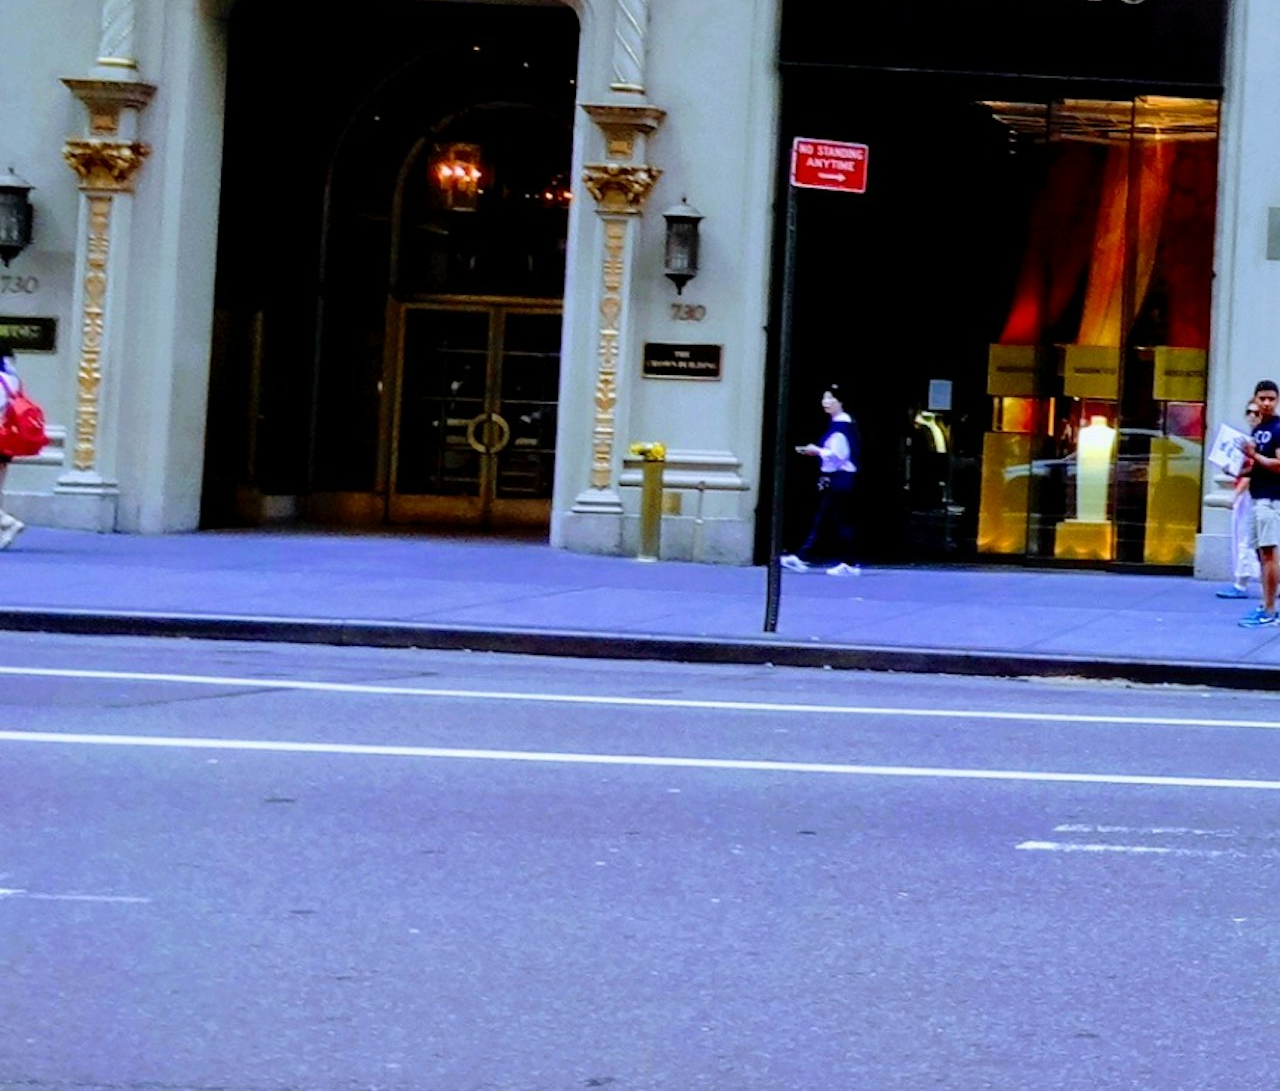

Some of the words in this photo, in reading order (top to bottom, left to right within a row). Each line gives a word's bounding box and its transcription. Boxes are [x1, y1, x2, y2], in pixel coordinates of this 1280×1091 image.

[798, 143, 814, 155] NO
[816, 145, 864, 160] STANDING
[806, 157, 855, 171] ANYTIME
[671, 303, 706, 321] 730
